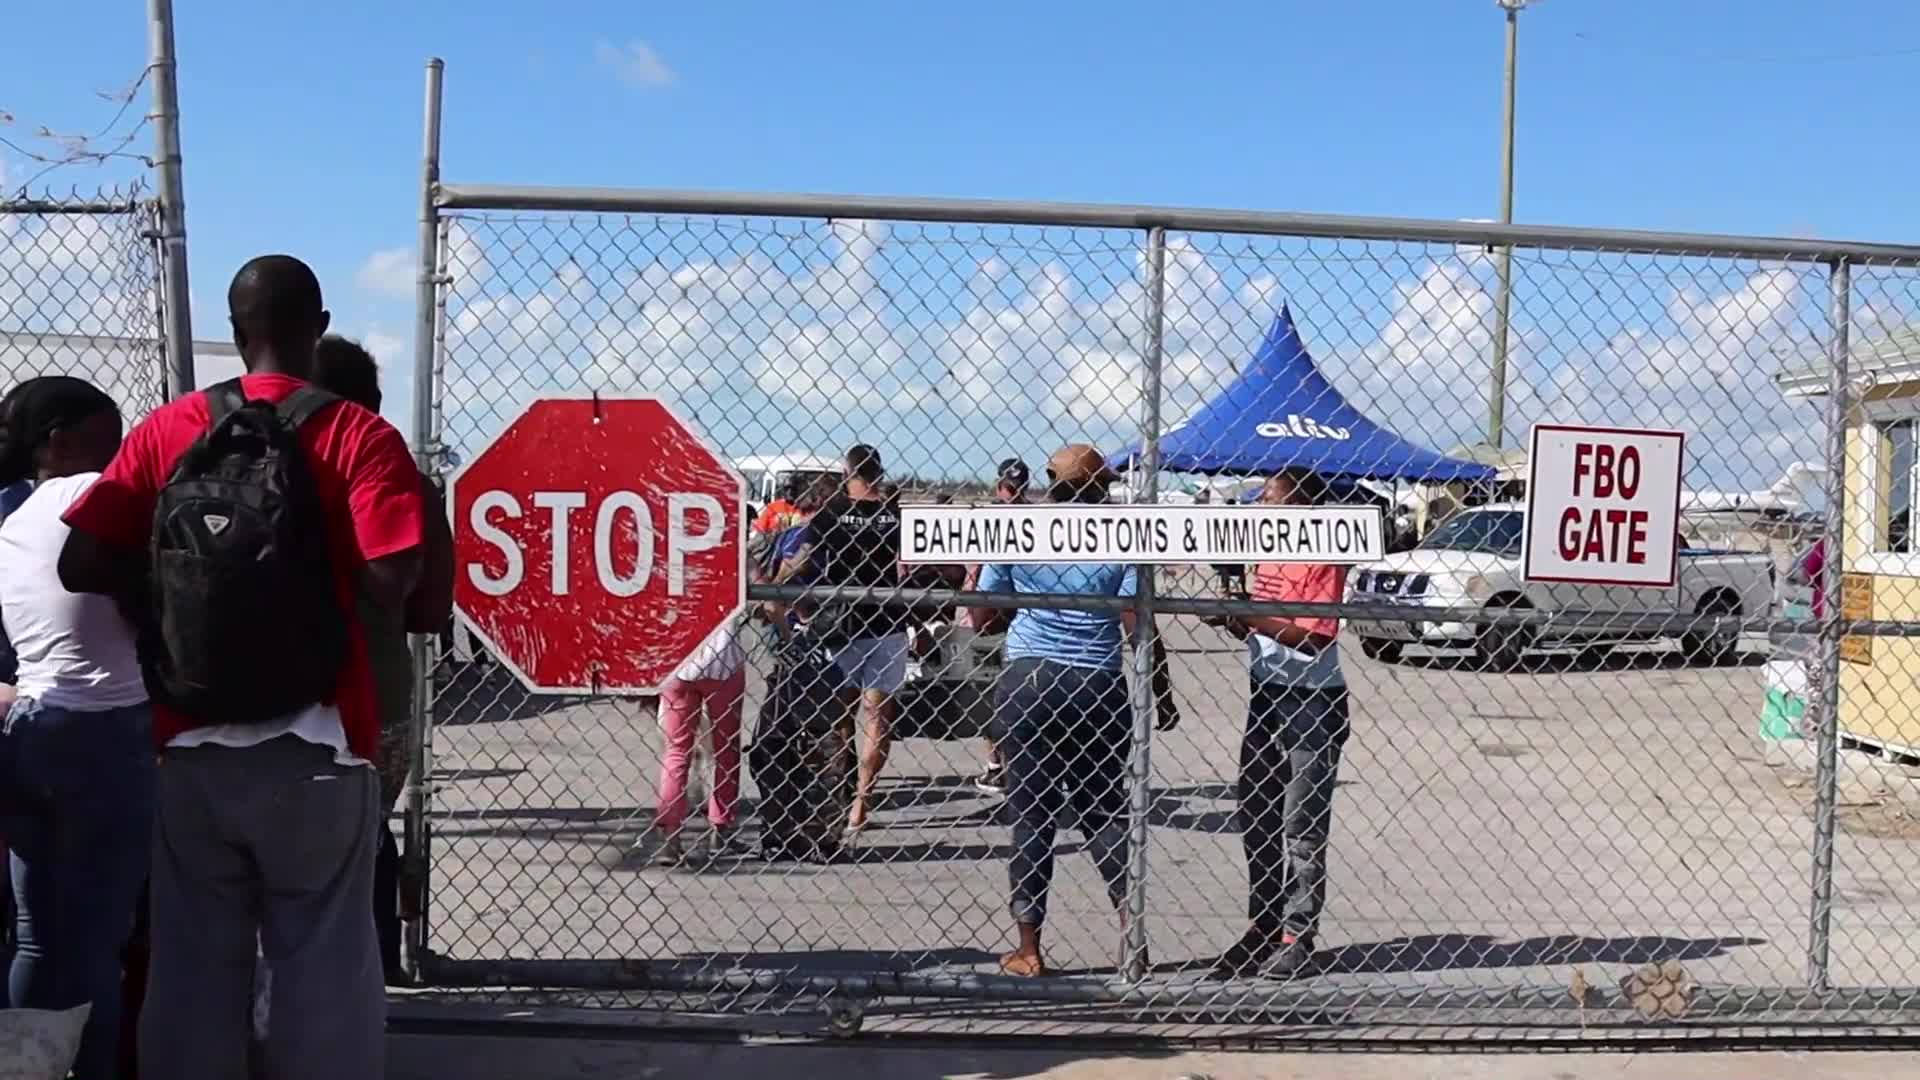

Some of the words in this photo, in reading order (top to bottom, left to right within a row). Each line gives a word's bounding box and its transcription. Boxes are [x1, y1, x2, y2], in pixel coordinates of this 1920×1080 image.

[1255, 414, 1350, 440] aliv
[1573, 443, 1640, 500] FBO
[468, 490, 725, 596] STOP
[913, 518, 1034, 553] BAHAMAS
[1049, 518, 1168, 553] CUSTOMS
[1183, 518, 1197, 552] &
[1206, 518, 1369, 553] IMMIGRATION
[1558, 506, 1648, 564] GATE
